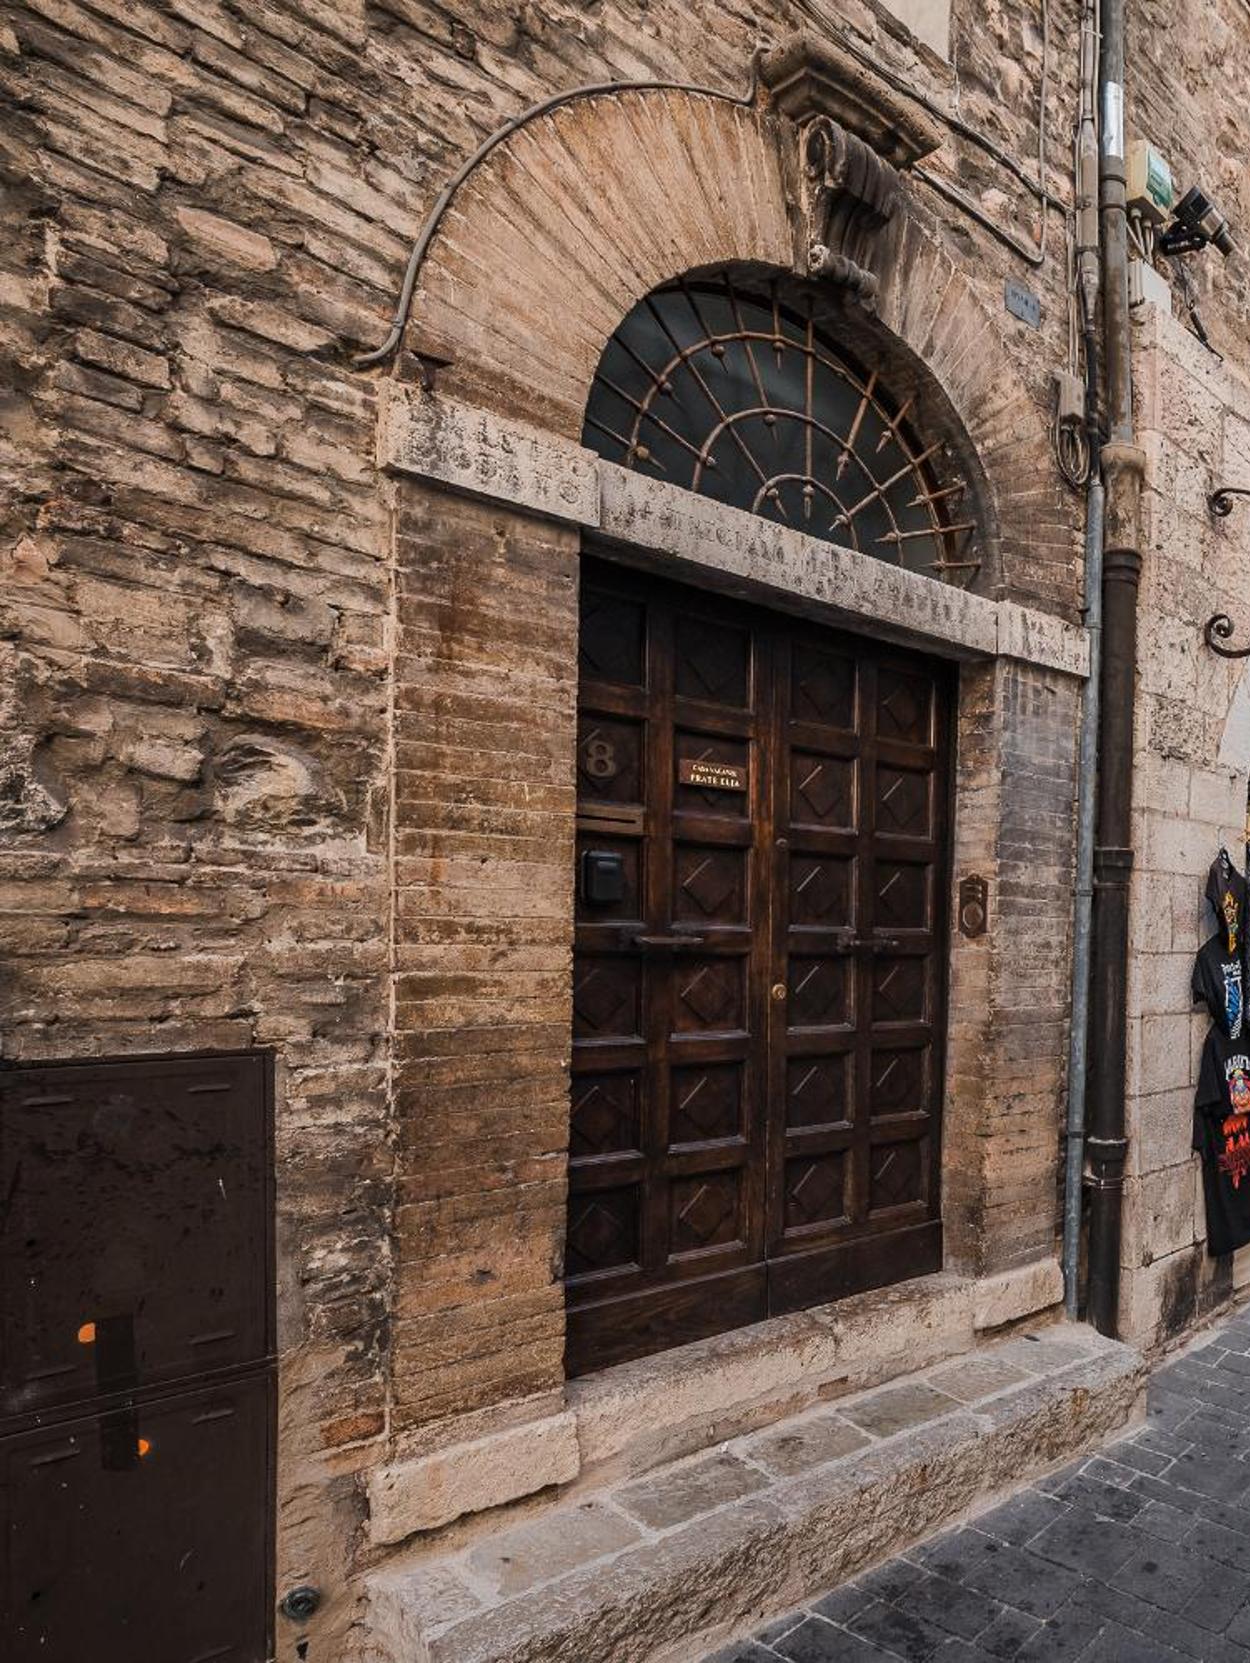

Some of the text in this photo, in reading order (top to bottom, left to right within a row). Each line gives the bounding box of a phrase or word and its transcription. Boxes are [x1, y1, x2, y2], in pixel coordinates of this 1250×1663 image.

[586, 740, 616, 777] 8
[690, 774, 740, 788] FRATE ELIA
